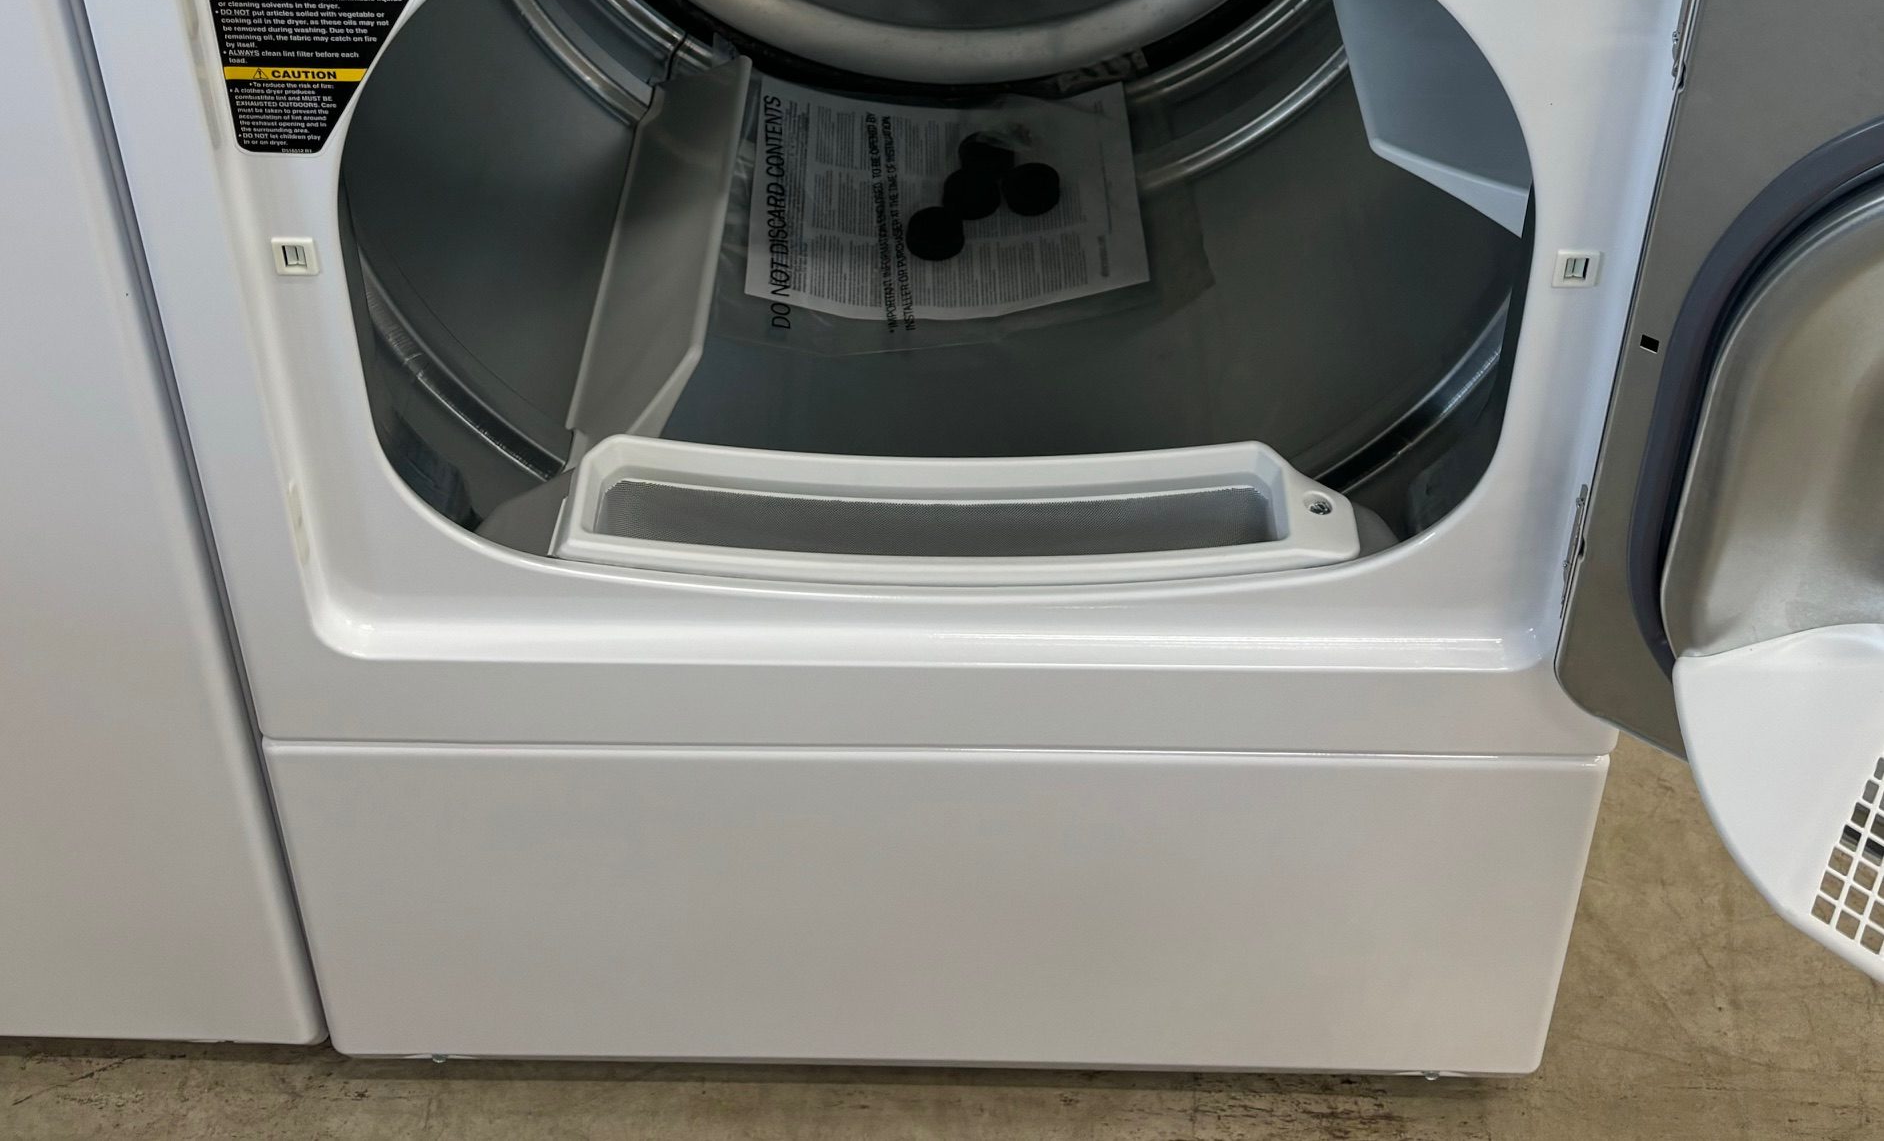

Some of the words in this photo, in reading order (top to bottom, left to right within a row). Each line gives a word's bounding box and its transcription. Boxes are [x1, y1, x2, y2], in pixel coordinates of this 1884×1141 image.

[228, 1, 260, 9] cleaning
[272, 70, 337, 79] CAUTION
[764, 95, 785, 177] CONTENTS
[767, 182, 789, 257] DISCARD
[770, 259, 790, 297] NOT
[771, 302, 791, 329] DO
